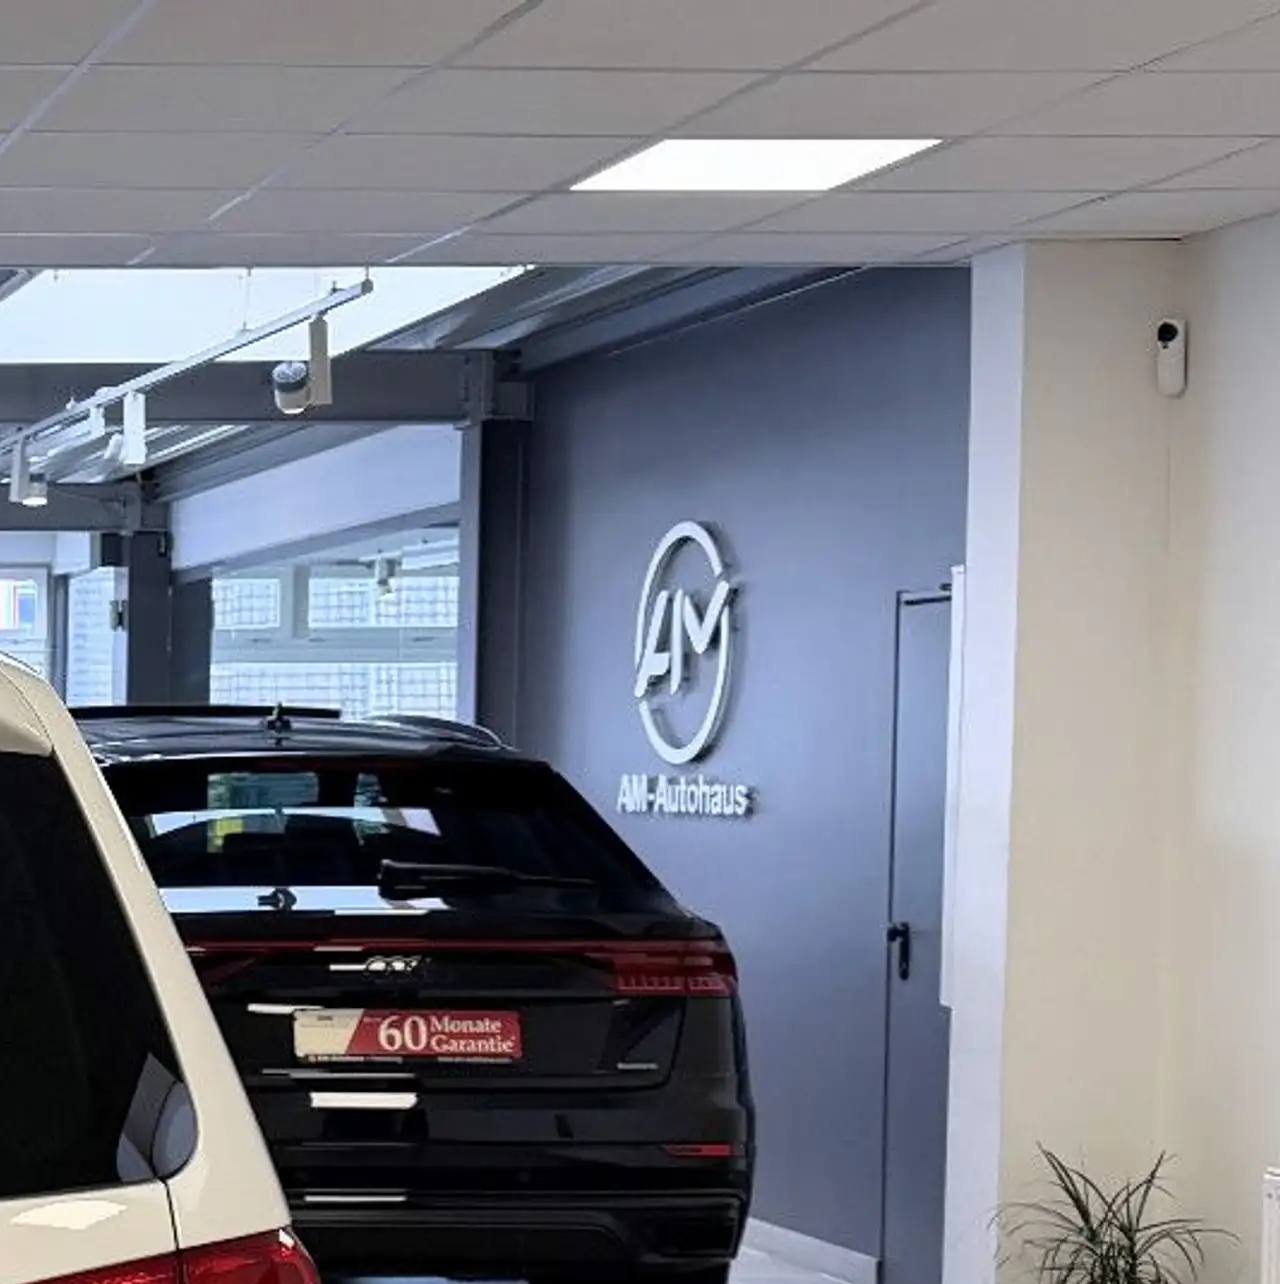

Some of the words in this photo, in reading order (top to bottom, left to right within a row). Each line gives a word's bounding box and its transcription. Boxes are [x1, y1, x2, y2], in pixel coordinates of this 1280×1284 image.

[617, 772, 750, 816] AM-Autohaus
[378, 1015, 428, 1051] 60
[429, 1016, 502, 1033] Monate
